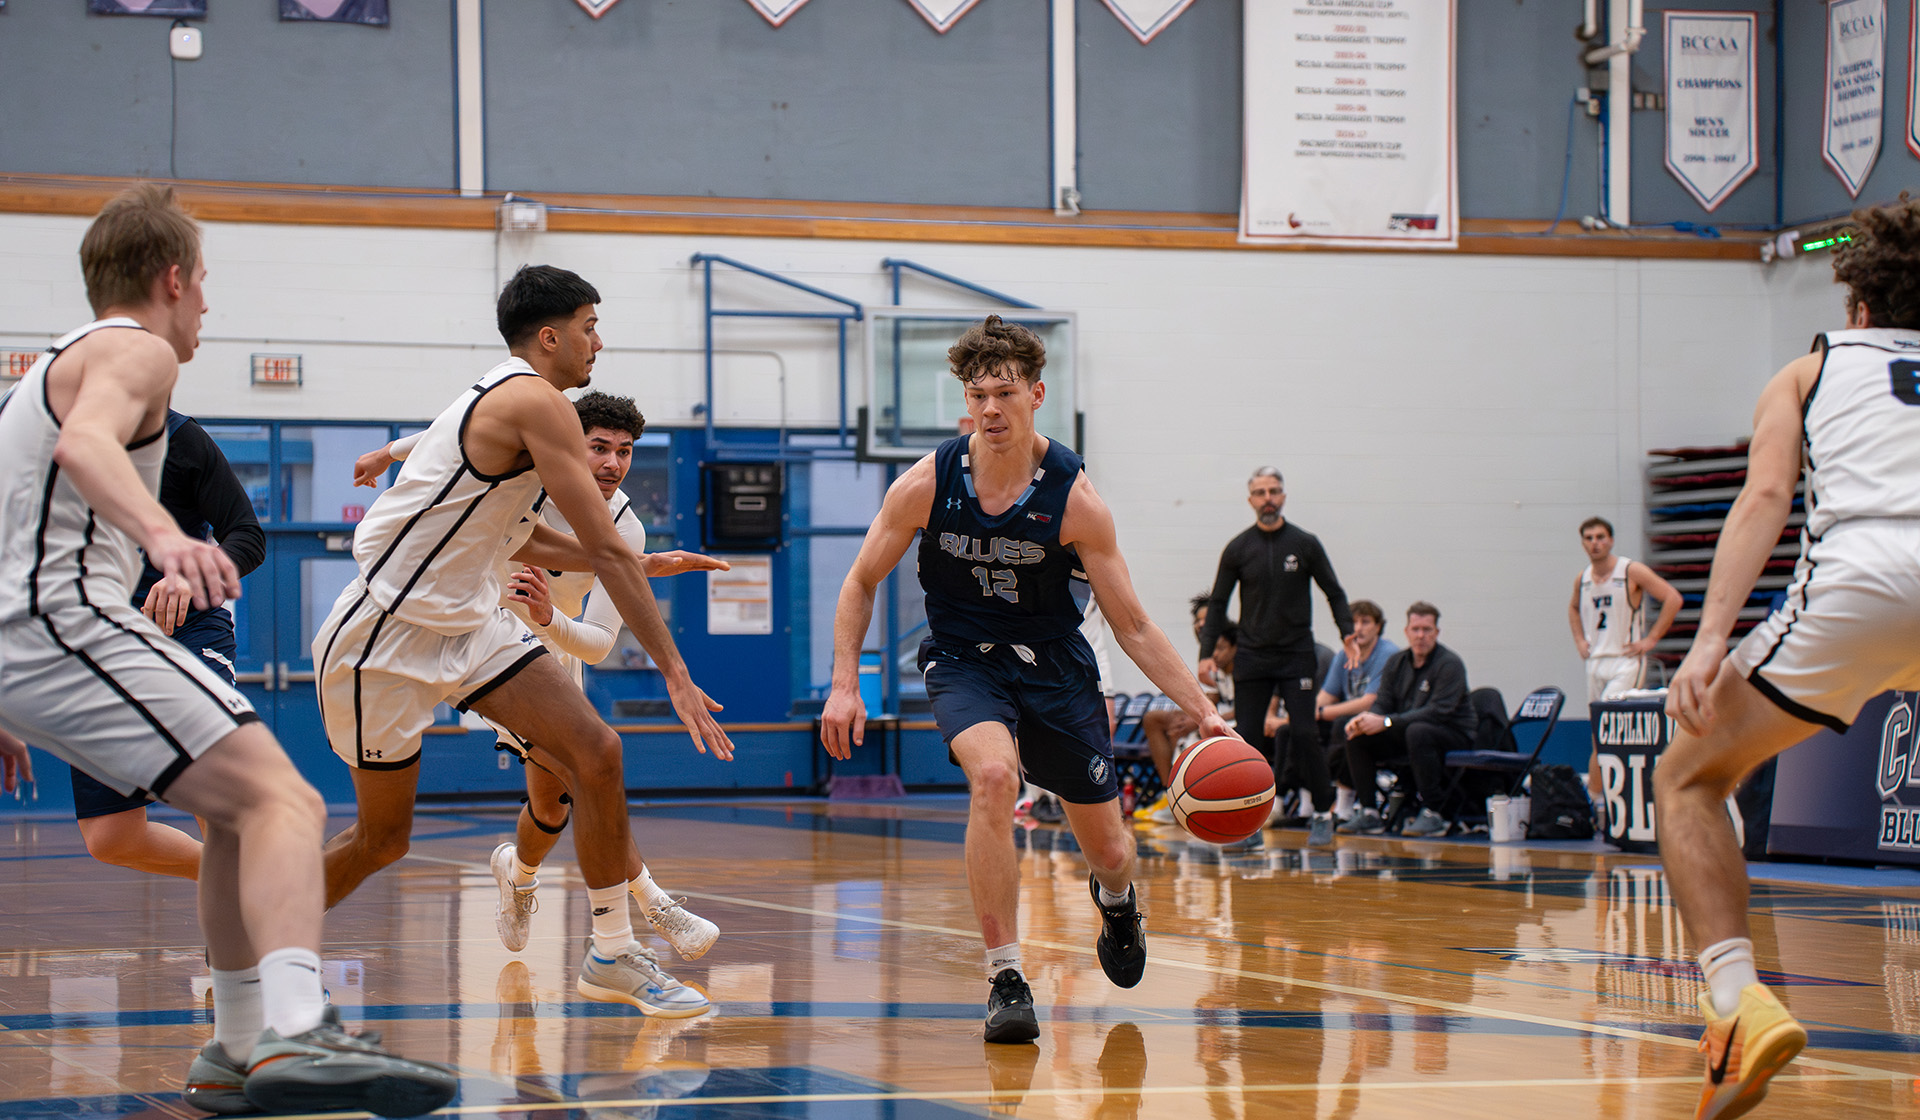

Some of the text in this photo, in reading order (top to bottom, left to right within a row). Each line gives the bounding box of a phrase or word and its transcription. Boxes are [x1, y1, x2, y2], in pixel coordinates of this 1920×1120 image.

[1681, 35, 1739, 50] BCCAA
[1677, 78, 1743, 89] CHAMPIONS
[1688, 128, 1730, 138] SOCCER
[940, 532, 1045, 565] BLUES
[971, 566, 1019, 603] 12
[1597, 611, 1607, 630] 2
[1598, 711, 1659, 746] CAPILANO
